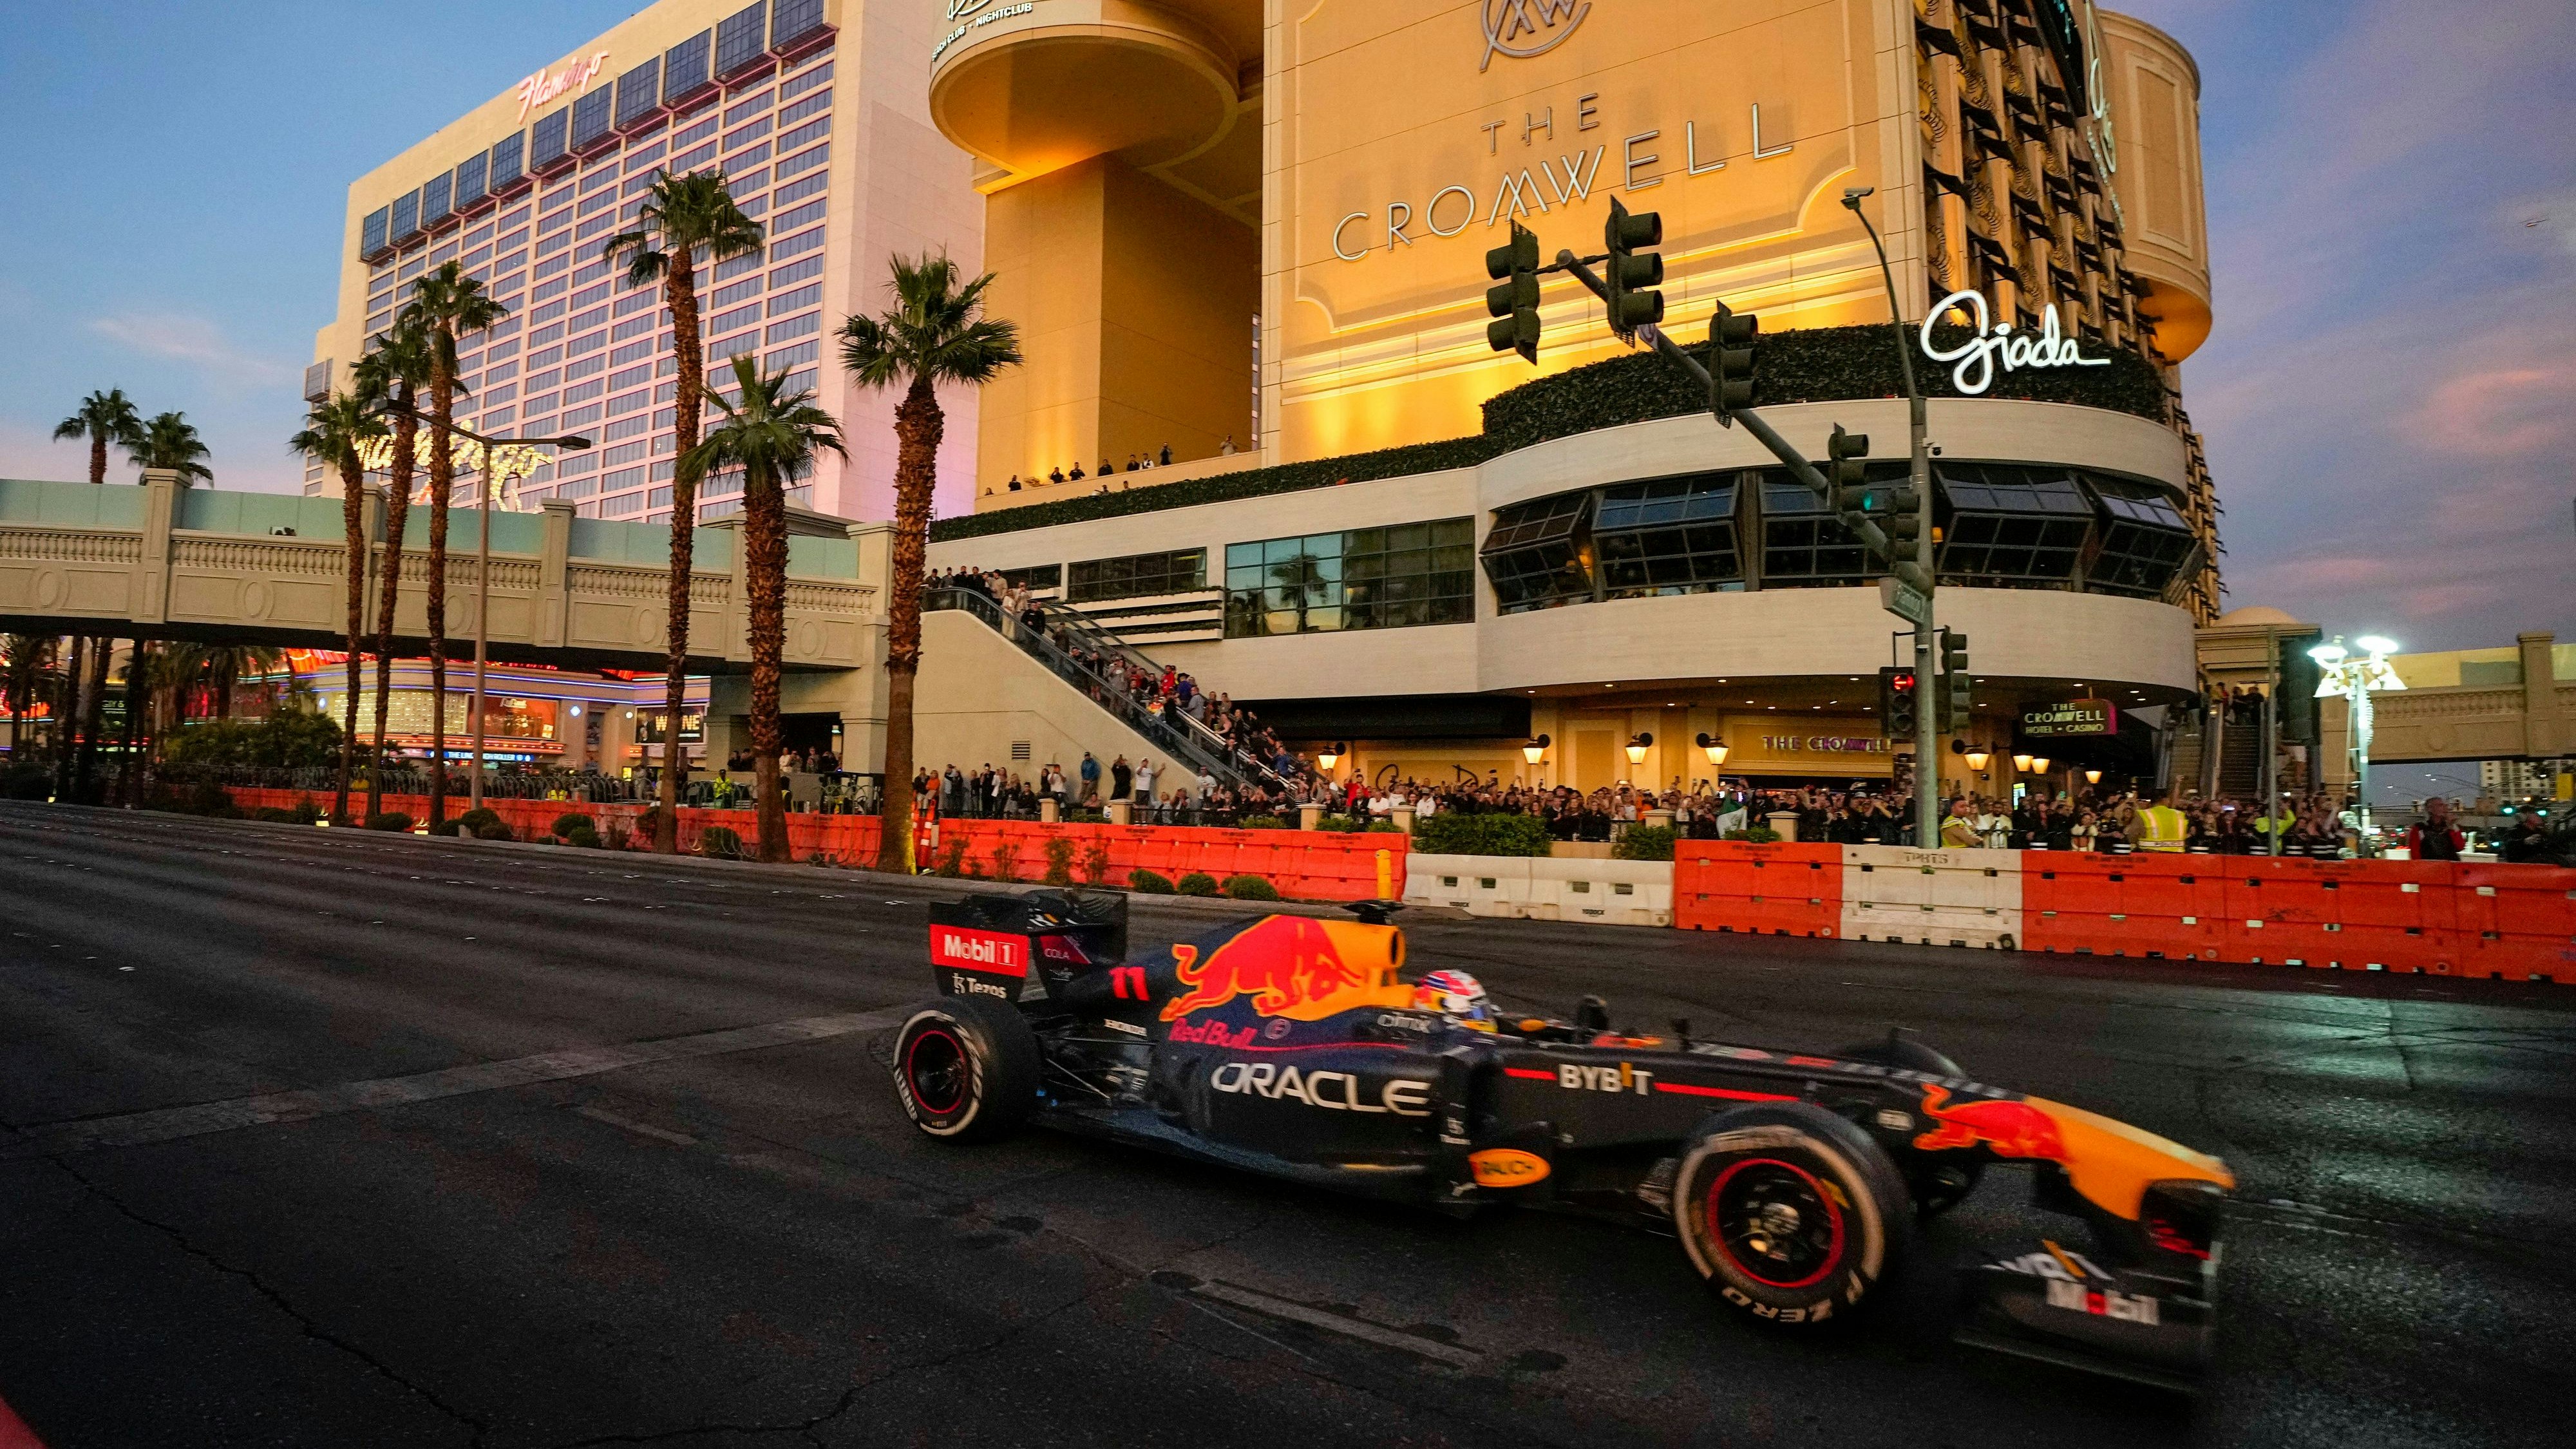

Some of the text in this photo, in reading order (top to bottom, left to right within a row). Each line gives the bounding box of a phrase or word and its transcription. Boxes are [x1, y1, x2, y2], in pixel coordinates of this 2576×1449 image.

[947, 25, 966, 44] CLUB
[976, 3, 1033, 27] NIGHTCLUB
[517, 50, 609, 125] Flamingo
[1481, 92, 1601, 155] THE
[1331, 102, 1794, 262] CROMWELL
[1919, 289, 2112, 395] Giada
[2024, 710, 2105, 723] CROMWELL
[2051, 703, 2076, 712] THE
[1763, 735, 1801, 751] THE
[2025, 723, 2105, 734] HOTEL CASINO
[944, 934, 996, 963] Mobil
[967, 977, 1007, 999] Tezos
[1108, 967, 1150, 1001] 11
[1211, 1063, 1432, 1117] ORACLE
[1558, 1062, 1655, 1095] BYBIT
